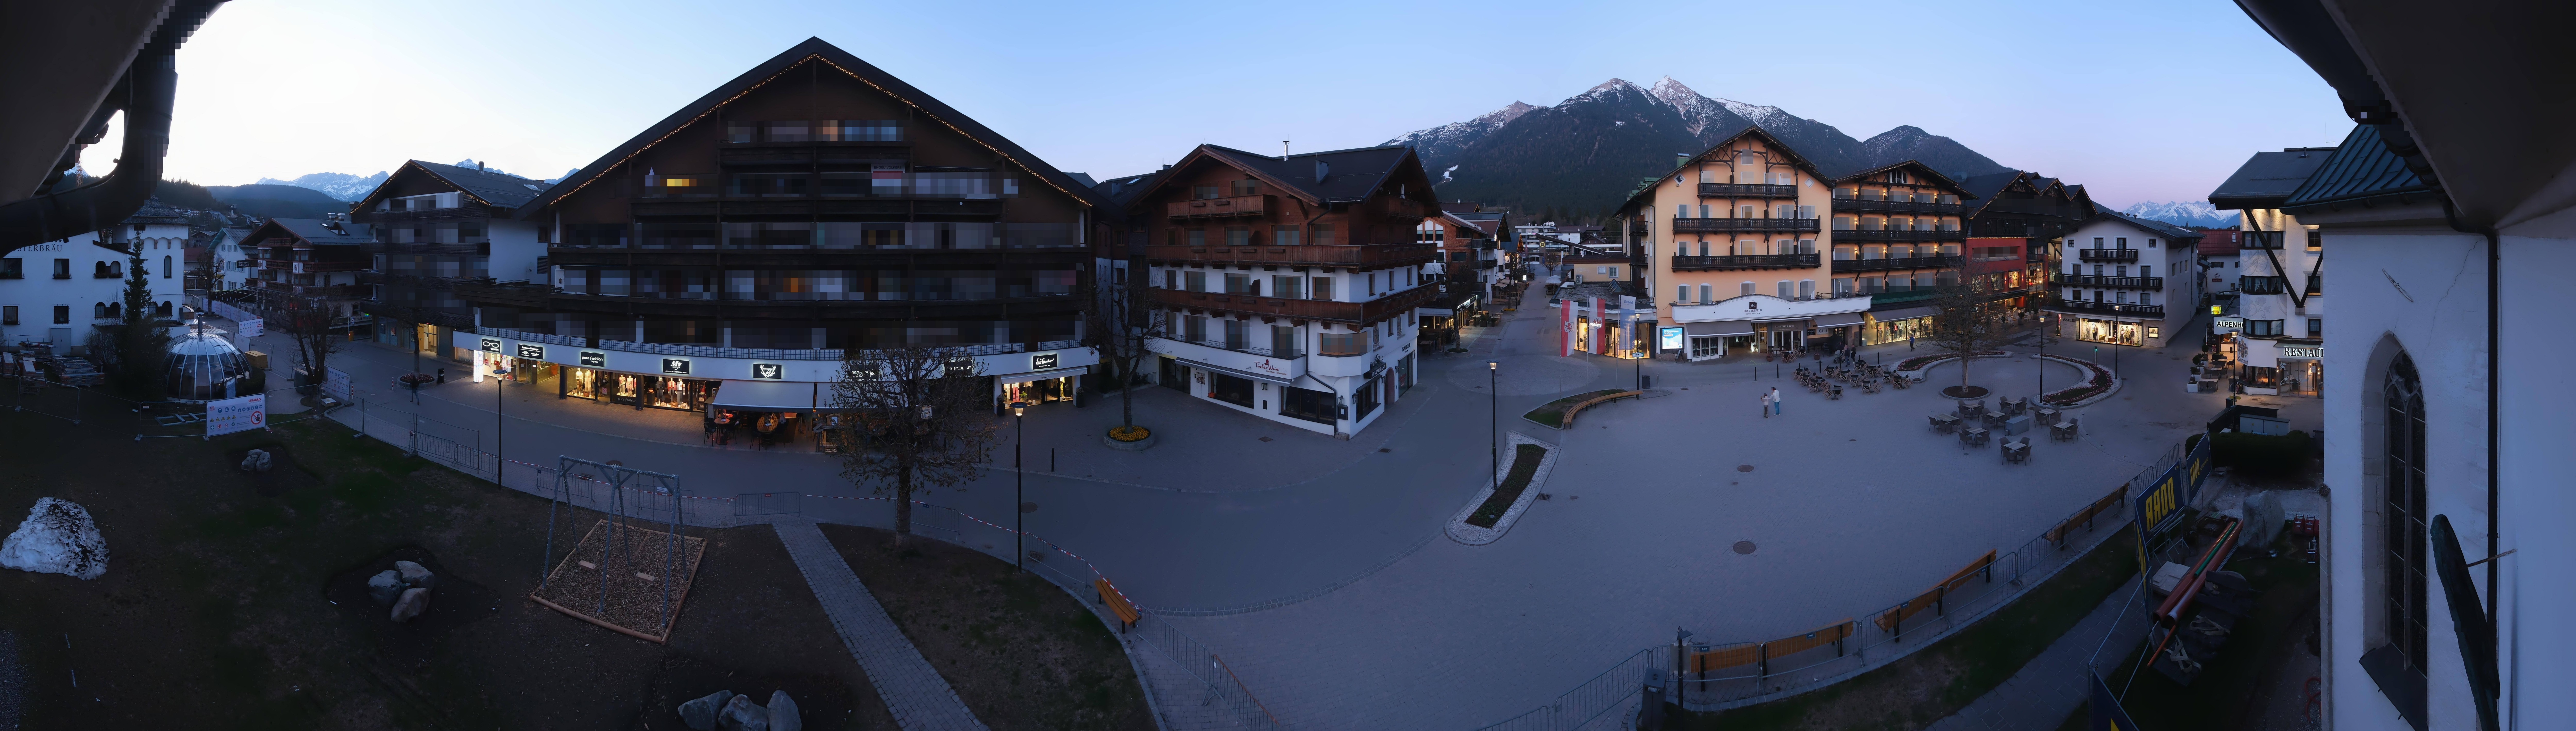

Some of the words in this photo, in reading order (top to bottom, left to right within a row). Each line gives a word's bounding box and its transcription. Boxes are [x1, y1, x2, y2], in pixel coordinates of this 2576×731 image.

[1402, 343, 1411, 352] SAILER
[670, 360, 682, 370] My
[1372, 364, 1385, 377] RESTAURANT
